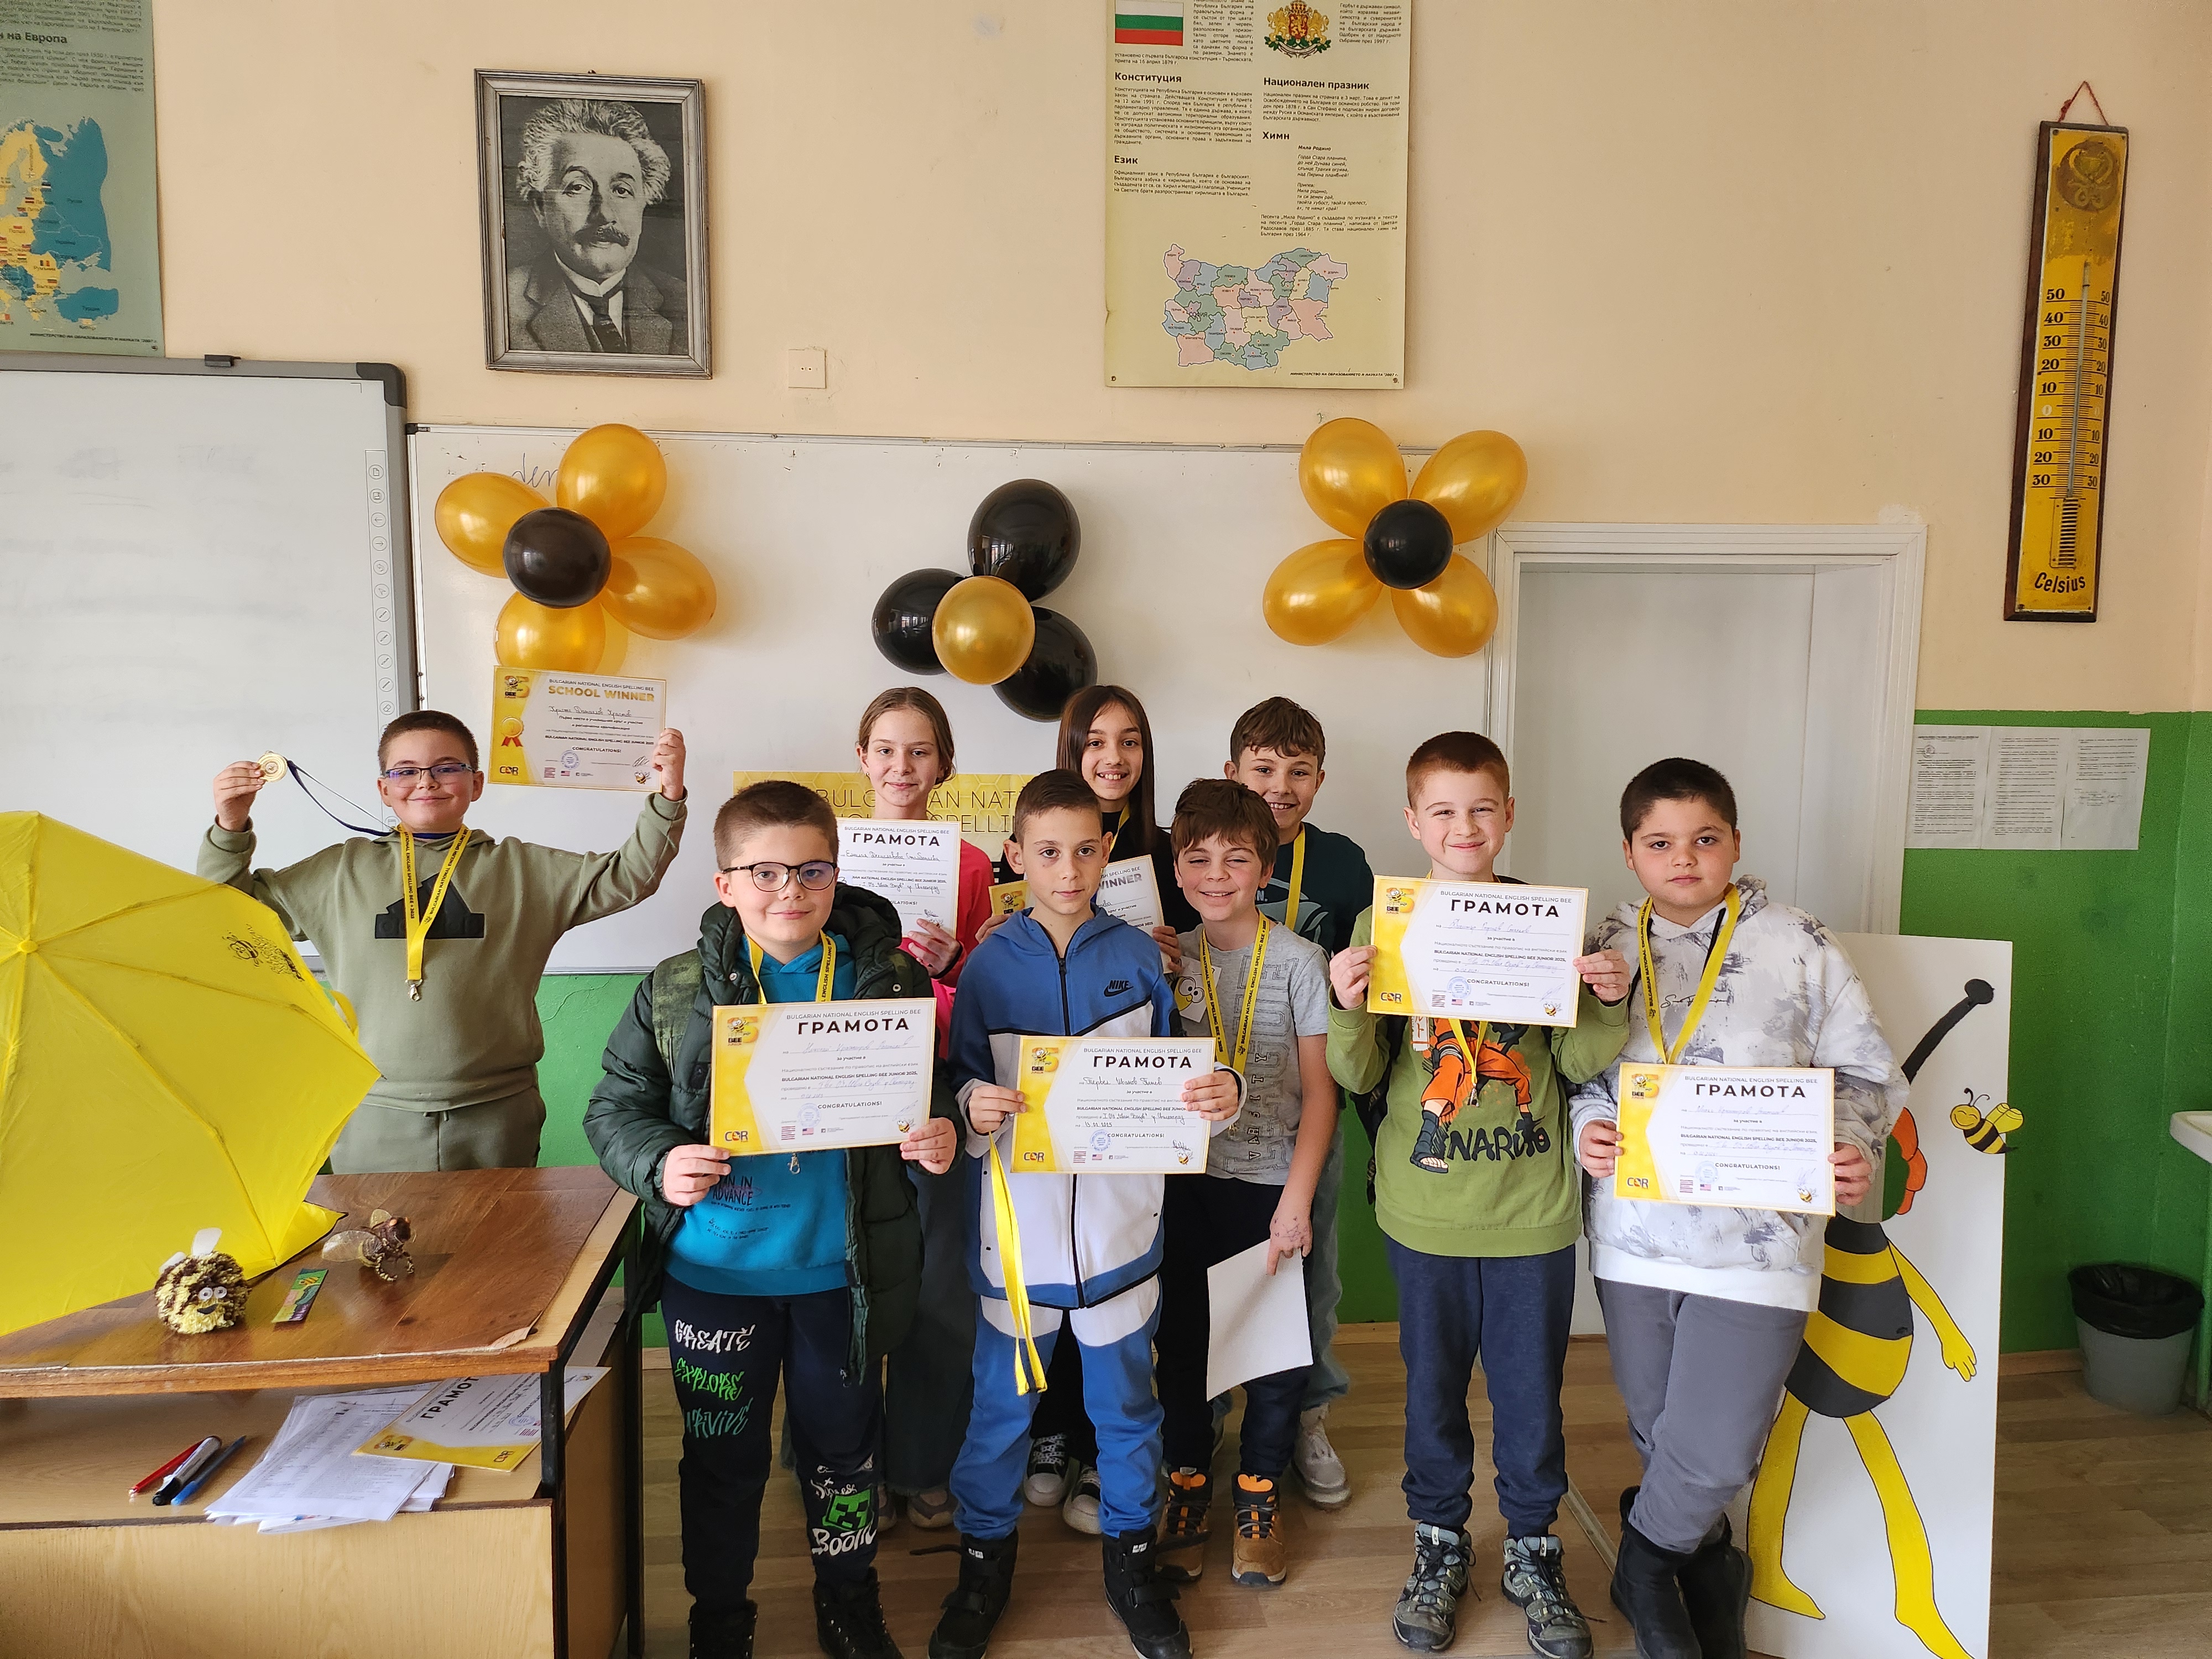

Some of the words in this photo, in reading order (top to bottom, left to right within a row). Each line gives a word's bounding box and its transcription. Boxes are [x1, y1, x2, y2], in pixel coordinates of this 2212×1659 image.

[25, 32, 67, 44] Европа
[1114, 72, 1182, 83] Конституция
[1264, 77, 1325, 87] Национален
[1328, 82, 1369, 90] празник
[1262, 132, 1290, 140] Химн
[1114, 155, 1138, 164] Език
[2046, 289, 2064, 300] 50
[2101, 291, 2110, 302] 50
[2044, 312, 2063, 323] 40
[2099, 314, 2108, 326] 40
[2044, 335, 2061, 346] 30
[2098, 337, 2106, 349] 30
[2041, 359, 2059, 369] 20
[2096, 361, 2105, 372] 20
[2042, 382, 2057, 393] 10
[2096, 384, 2104, 395] 10
[2042, 405, 2052, 416] 0
[2038, 428, 2053, 439] 10
[2092, 430, 2100, 441] 10
[2034, 452, 2052, 462] 20
[2090, 453, 2099, 464] 20
[2033, 474, 2050, 485] 30
[2088, 476, 2097, 487] 30
[2035, 572, 2085, 593] Celsius
[549, 686, 600, 697] SCHOOL
[604, 690, 654, 702] WINNER
[853, 833, 940, 846] ГРАМОТА
[1451, 899, 1559, 917] ГРАМОТА
[1109, 980, 1129, 989] NIKE
[1245, 989, 1254, 1014] NATIONAL
[799, 1018, 909, 1035] ГРАМОТА
[1094, 1056, 1192, 1068] ГРАМОТА
[1696, 1084, 1806, 1098] ГРАМОТА
[741, 1176, 752, 1189] IN
[713, 1187, 753, 1206] ADVANCE
[675, 1319, 756, 1354] CREATE
[675, 1357, 744, 1400] EXPLORE
[420, 1376, 479, 1419] ГРАМОТ
